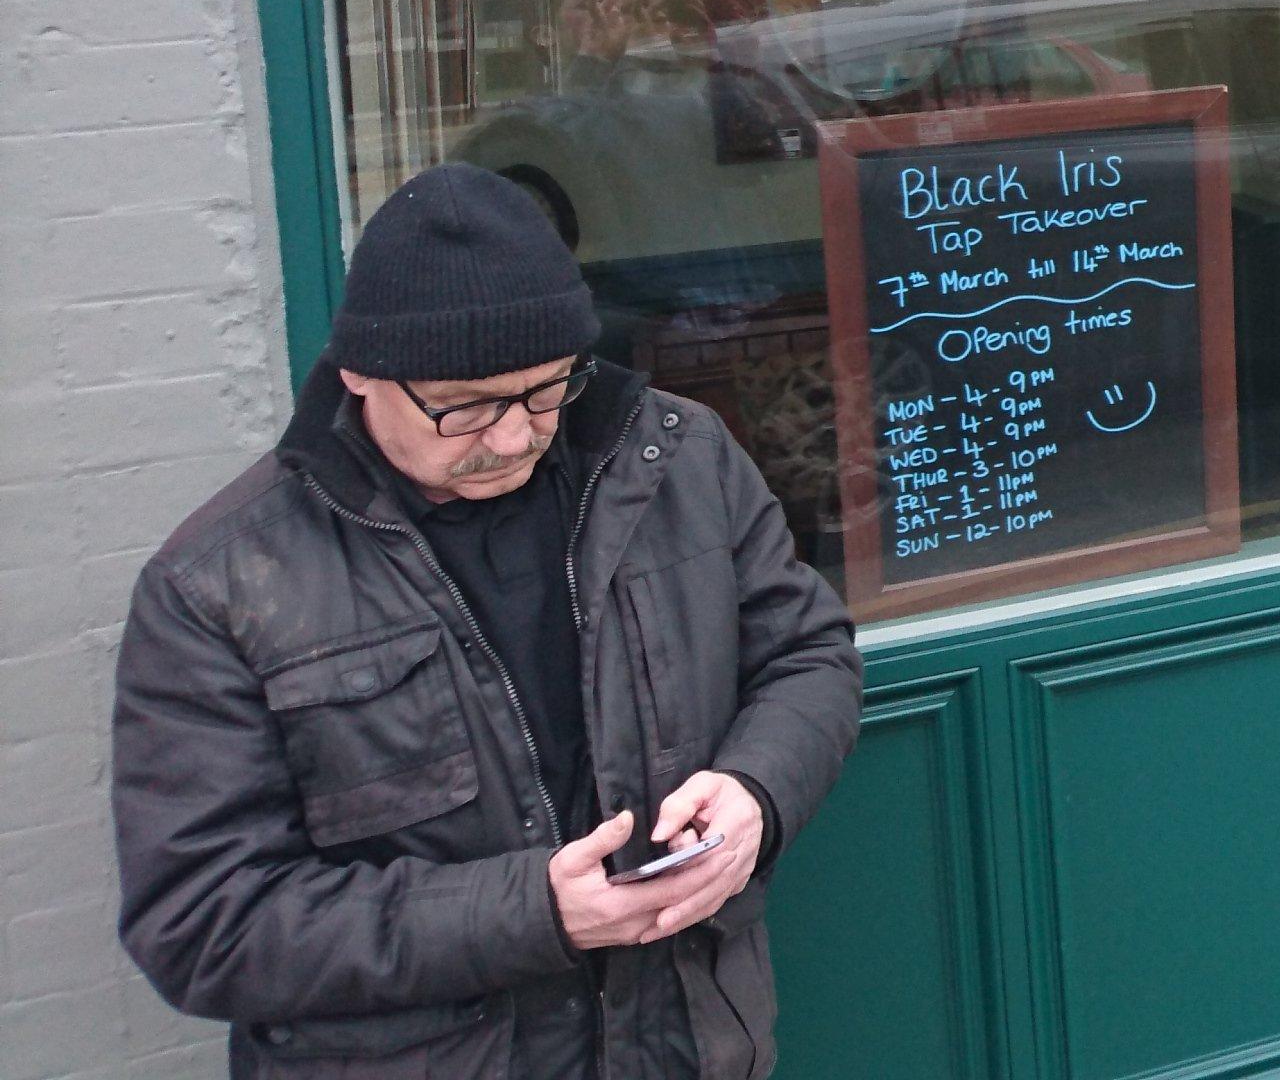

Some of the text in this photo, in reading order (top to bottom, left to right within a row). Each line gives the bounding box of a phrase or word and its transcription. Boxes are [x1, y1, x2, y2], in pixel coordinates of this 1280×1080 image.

[899, 150, 1123, 220] Black Iris
[916, 199, 1147, 256] Tap Takeover
[939, 267, 1009, 295] March
[1027, 258, 1056, 279] till
[1118, 242, 1184, 263] March
[937, 308, 1132, 362] Opening times
